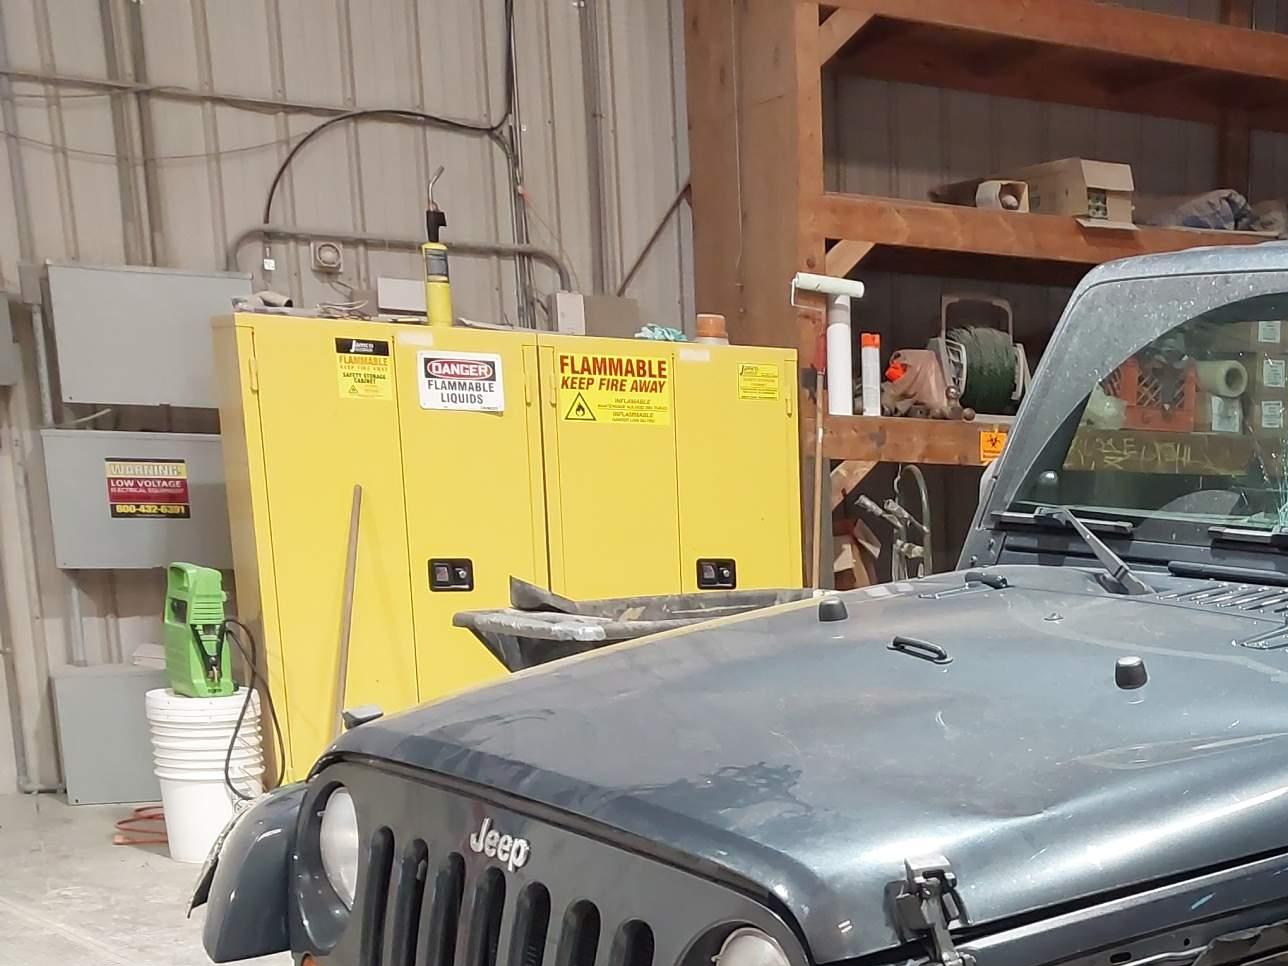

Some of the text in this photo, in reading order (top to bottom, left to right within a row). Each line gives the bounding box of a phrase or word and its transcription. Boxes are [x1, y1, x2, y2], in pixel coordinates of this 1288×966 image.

[339, 355, 388, 366] FLAMMABLE
[560, 355, 667, 379] FLAMMABLE
[432, 362, 488, 377] DANGER
[428, 379, 495, 393] FLAMMABLE
[561, 376, 666, 393] KEEP FIRE AWAY
[441, 393, 483, 404] LIQUIDS
[110, 479, 182, 488] LOW VOLTAGE
[470, 818, 530, 872] Jeep
